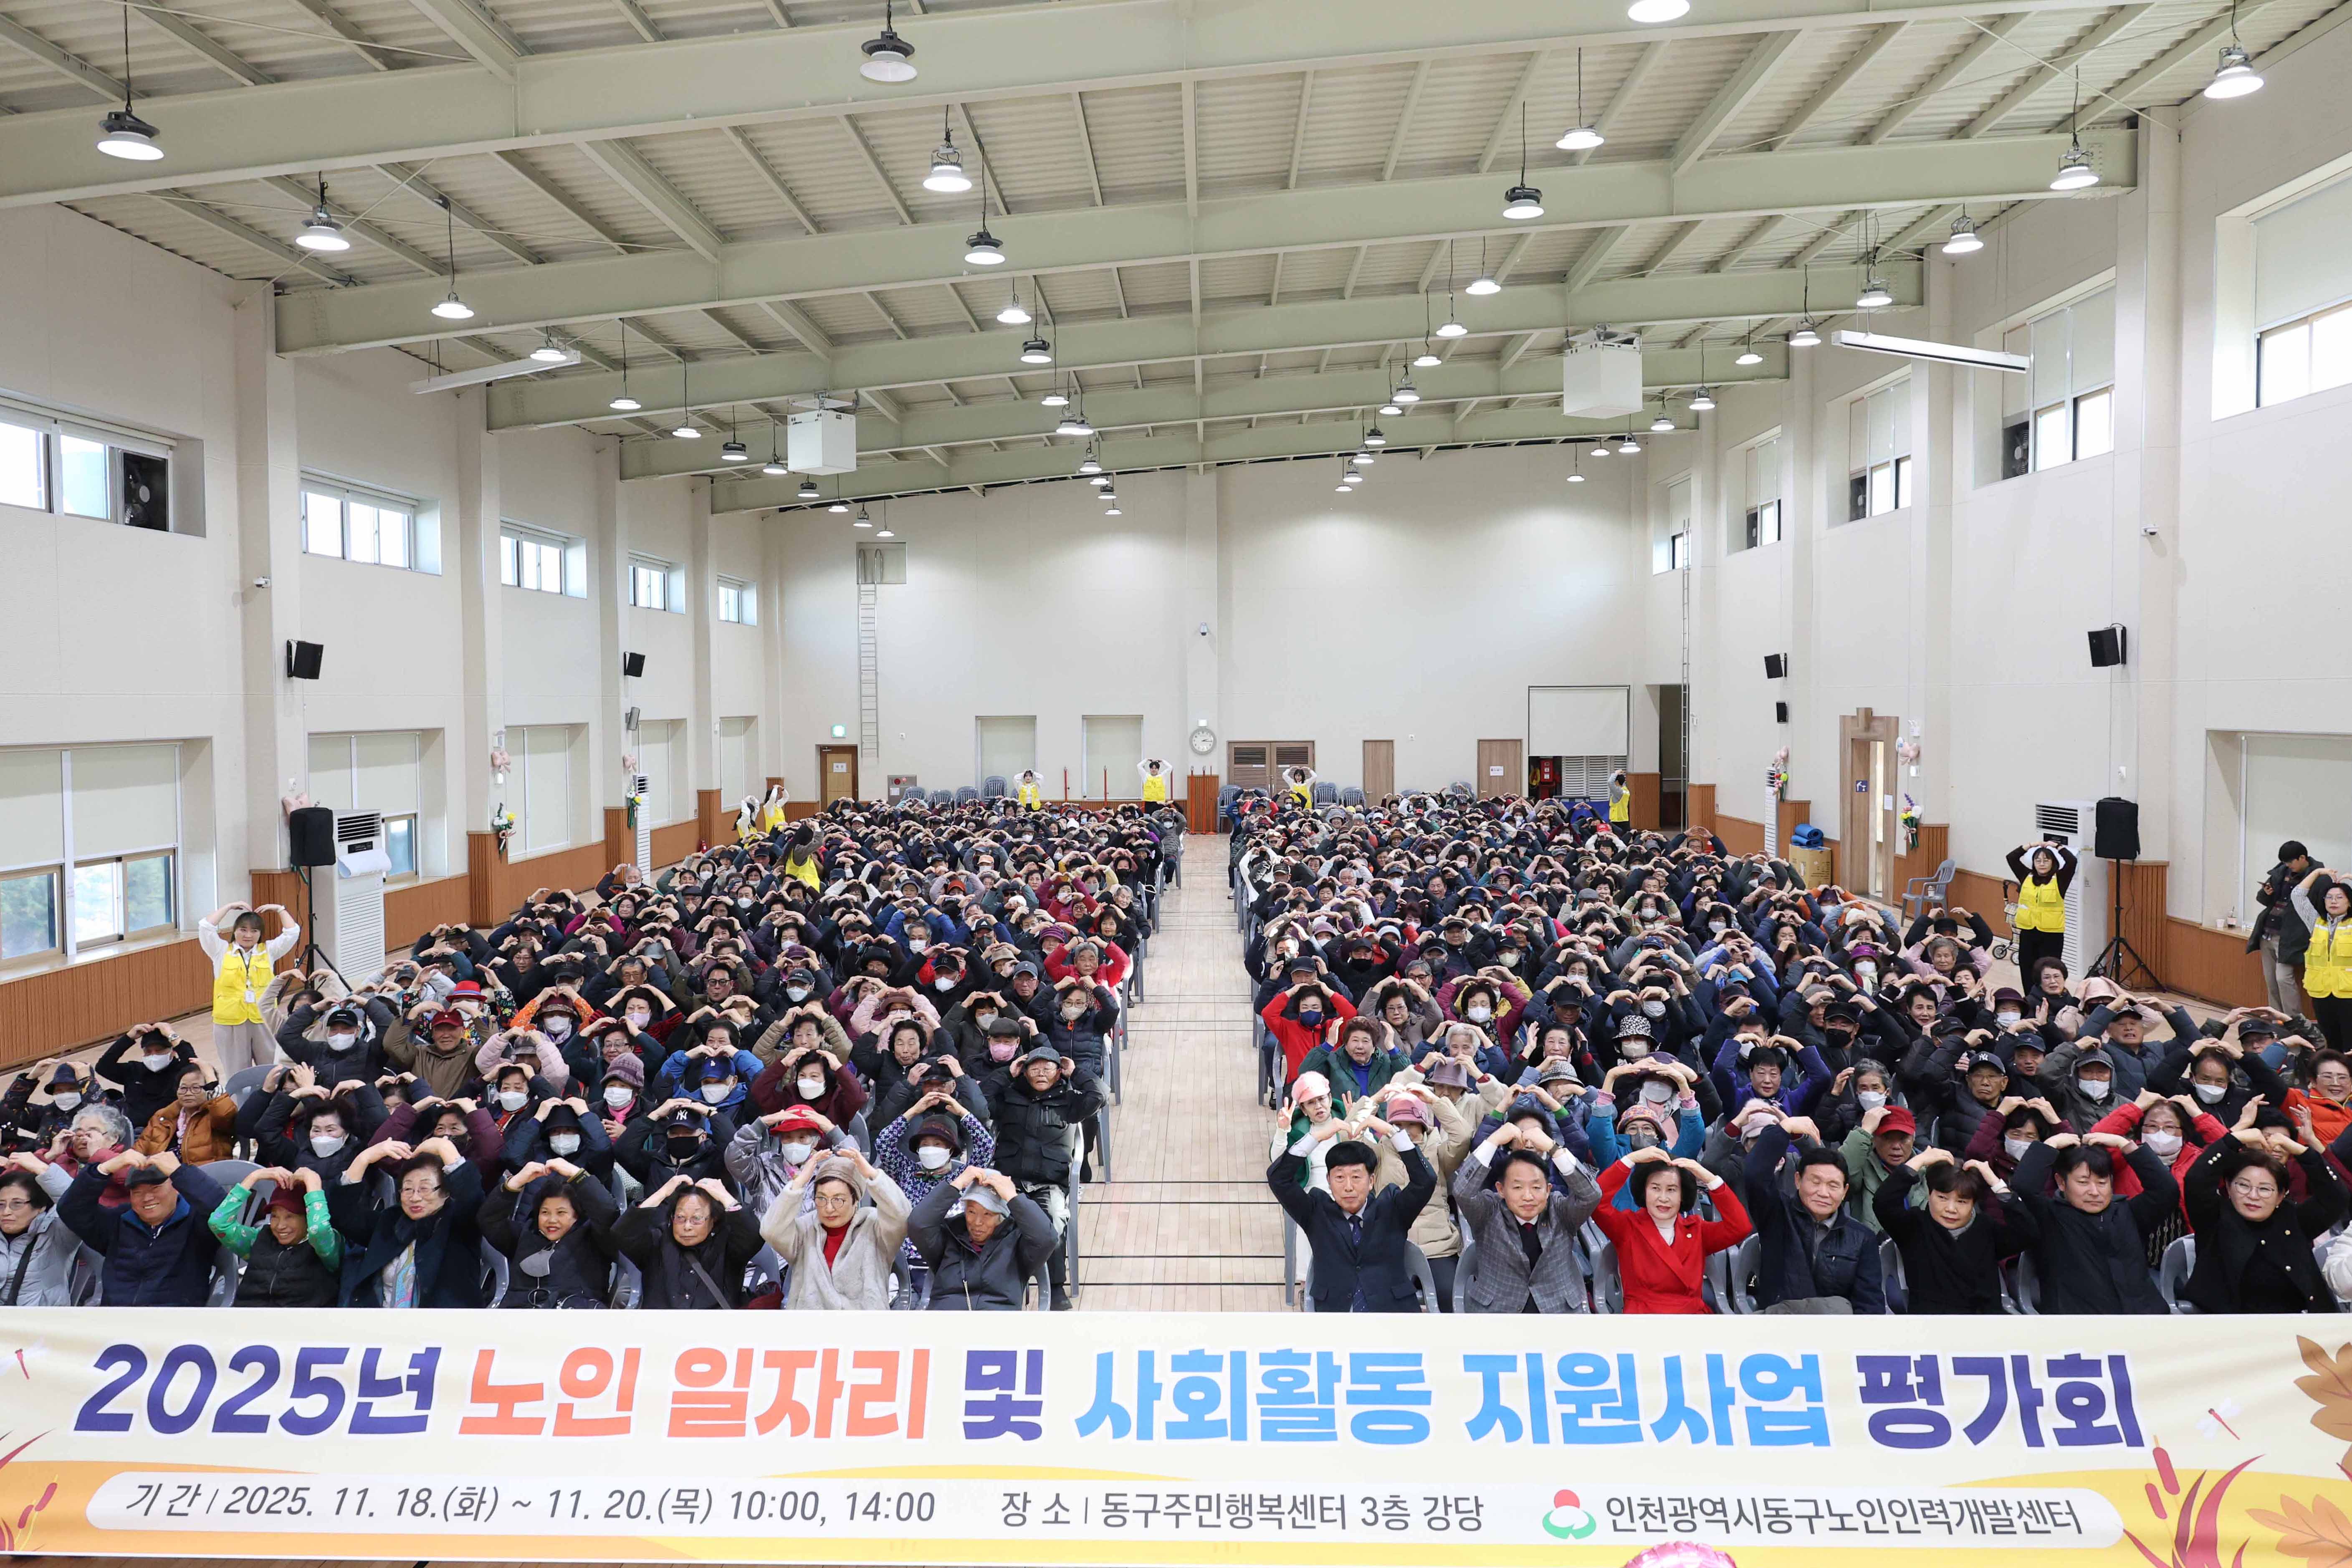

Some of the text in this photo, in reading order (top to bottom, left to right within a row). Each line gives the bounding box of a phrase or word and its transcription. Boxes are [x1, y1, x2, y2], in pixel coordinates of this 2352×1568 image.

[676, 1109, 688, 1120] NY
[74, 1344, 2145, 1449] 2025년 노인 일자리 및 사회활동 지원사업 평가회
[223, 1486, 312, 1516] 2025.
[335, 1487, 374, 1517] 11.
[397, 1486, 498, 1522] 18.(화)
[550, 1490, 589, 1519] 11.
[604, 1488, 713, 1524] 20.(목)
[731, 1491, 826, 1526] 10:00,
[847, 1492, 935, 1521] 14:00
[1101, 1493, 1345, 1530] 동구주민행복센터
[1361, 1495, 1410, 1530] 3층
[1423, 1495, 1484, 1531] 강당
[1606, 1496, 2083, 1535] 인천광역시동구노인인력개발센터
